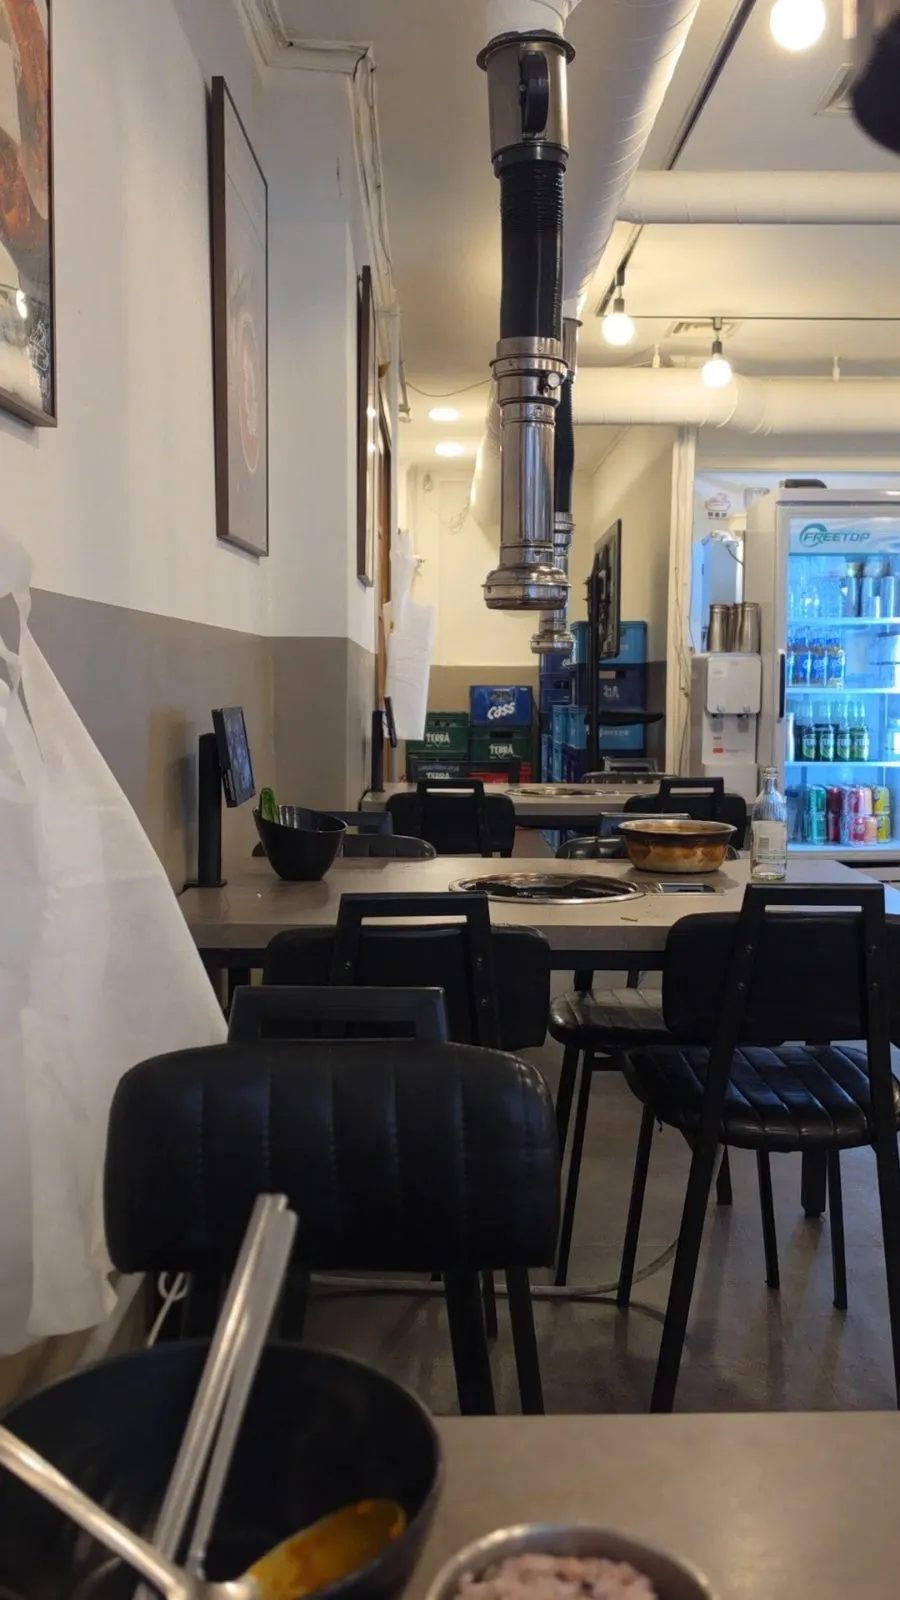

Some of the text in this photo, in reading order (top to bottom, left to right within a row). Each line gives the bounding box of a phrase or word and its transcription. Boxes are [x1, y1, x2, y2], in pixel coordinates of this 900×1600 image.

[803, 532, 872, 544] FREETOP
[425, 732, 450, 743] TERRA
[489, 744, 514, 755] TERRA
